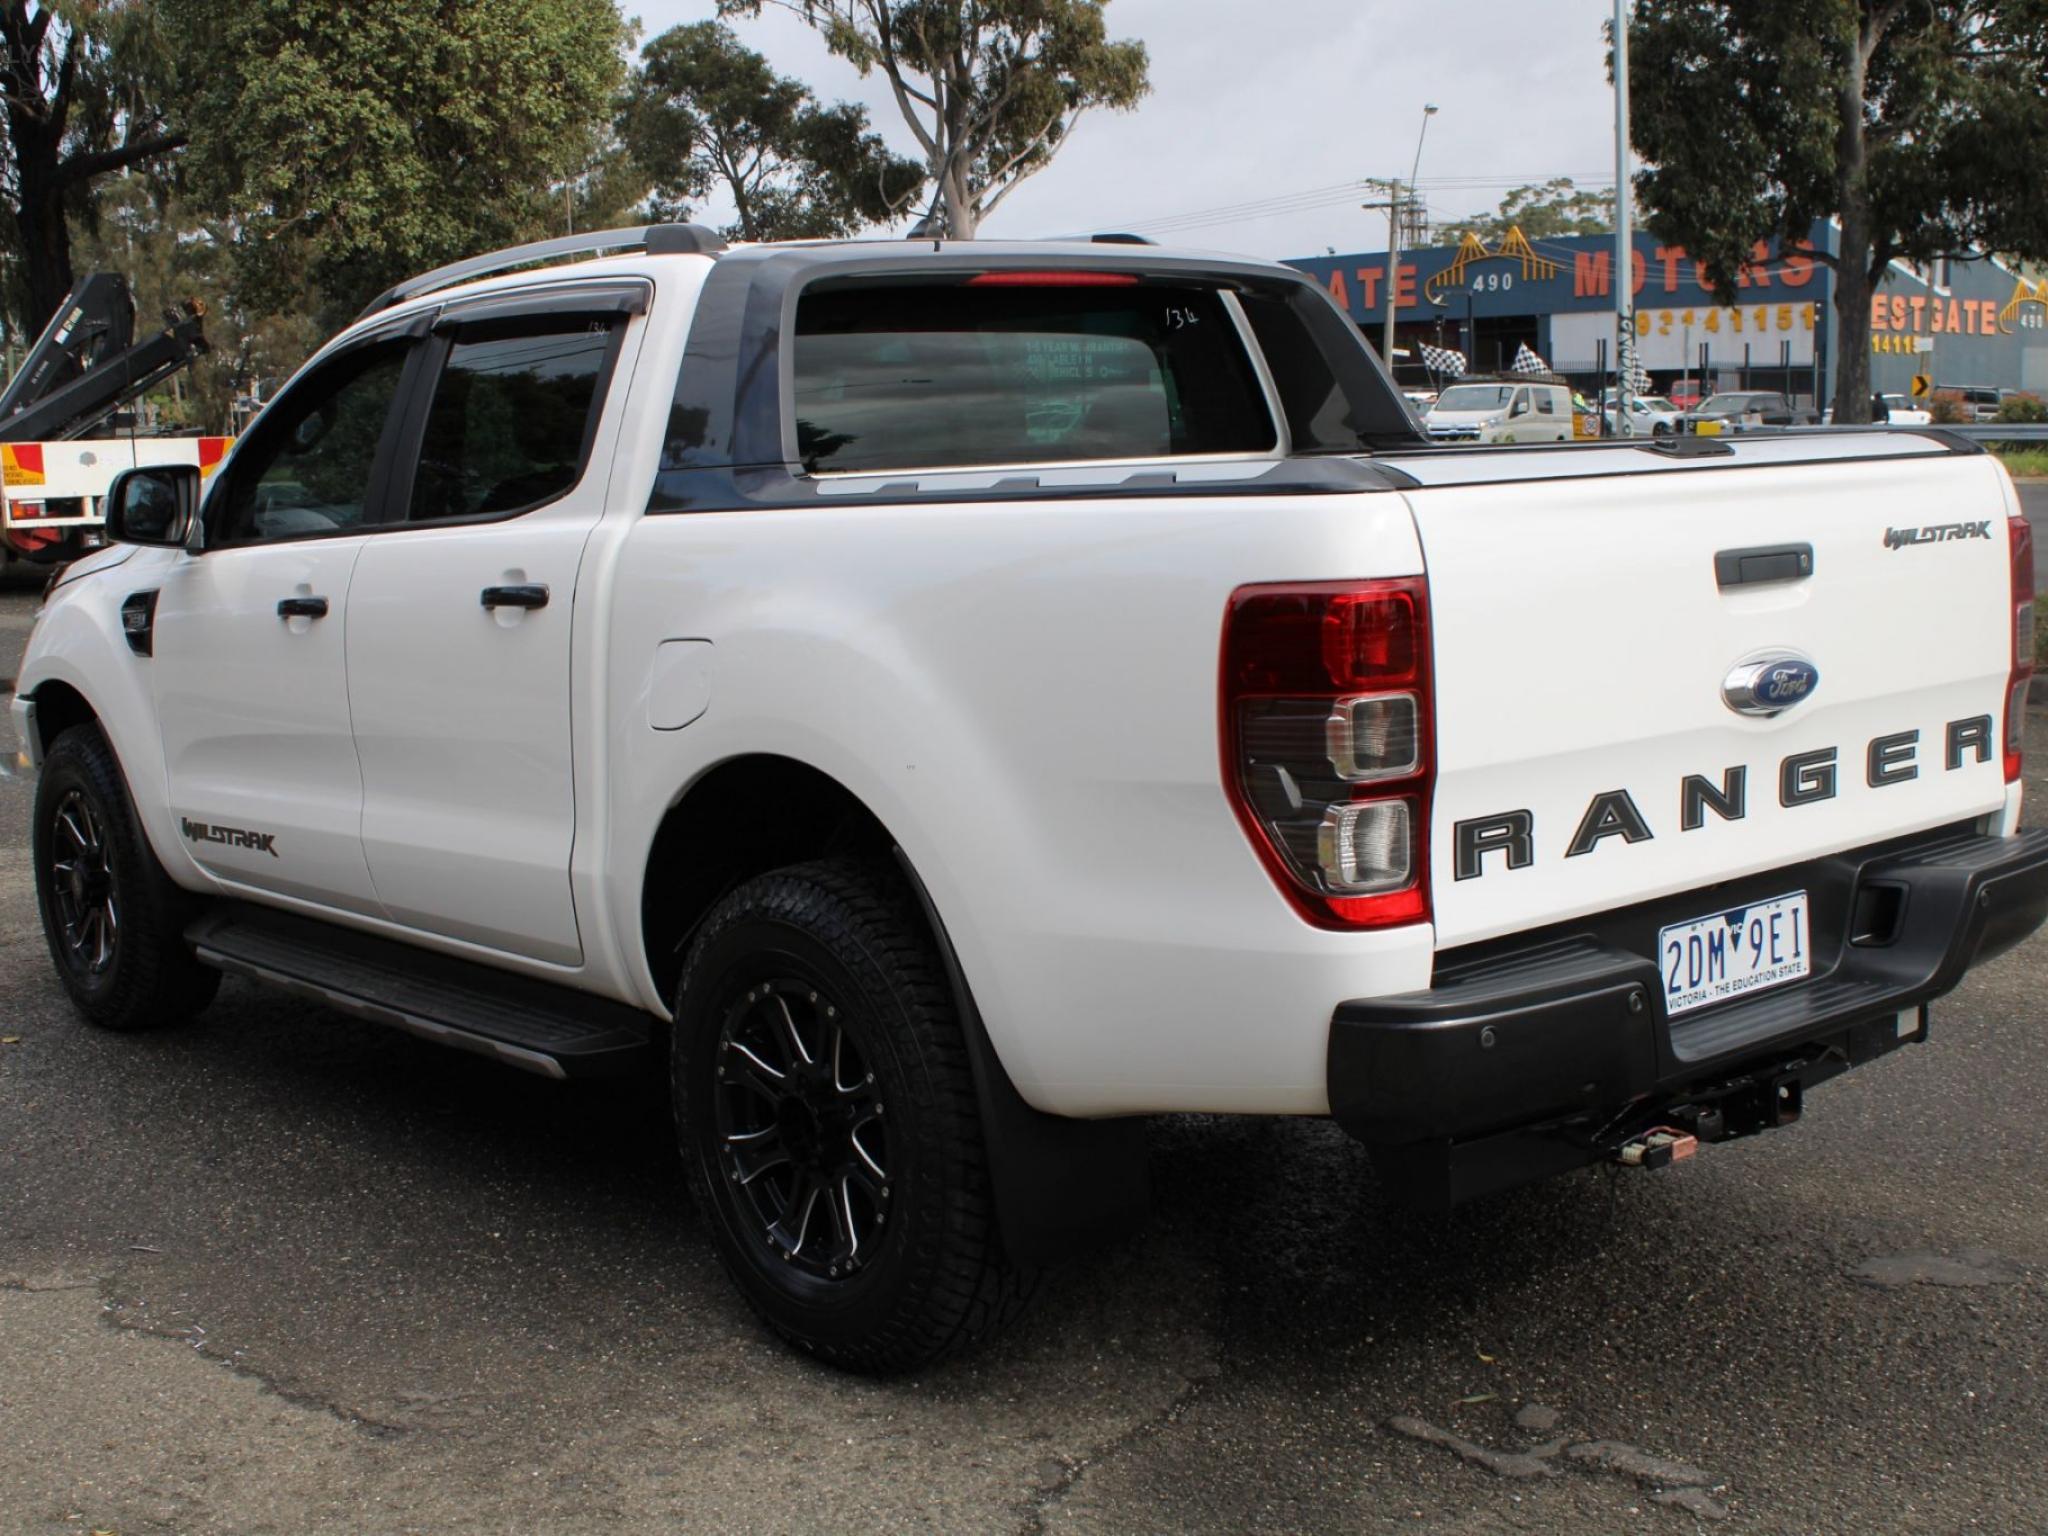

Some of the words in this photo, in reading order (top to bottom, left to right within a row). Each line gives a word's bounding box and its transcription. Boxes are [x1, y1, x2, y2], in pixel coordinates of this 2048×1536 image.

[1306, 264, 1418, 311] ATE
[1473, 272, 1512, 292] 490
[1166, 307, 1199, 329] 134
[1884, 520, 1992, 551] WILDTRAK
[1769, 668, 1808, 698] Ford
[1453, 714, 1992, 881] RANGER
[182, 817, 278, 858] WILDTRAK
[1667, 926, 1725, 994] 2DM
[1669, 990, 1707, 1009] VICTORIA
[1715, 982, 1730, 996] THE
[1732, 969, 1776, 991] EDUCATION
[1778, 962, 1801, 977] STATE
